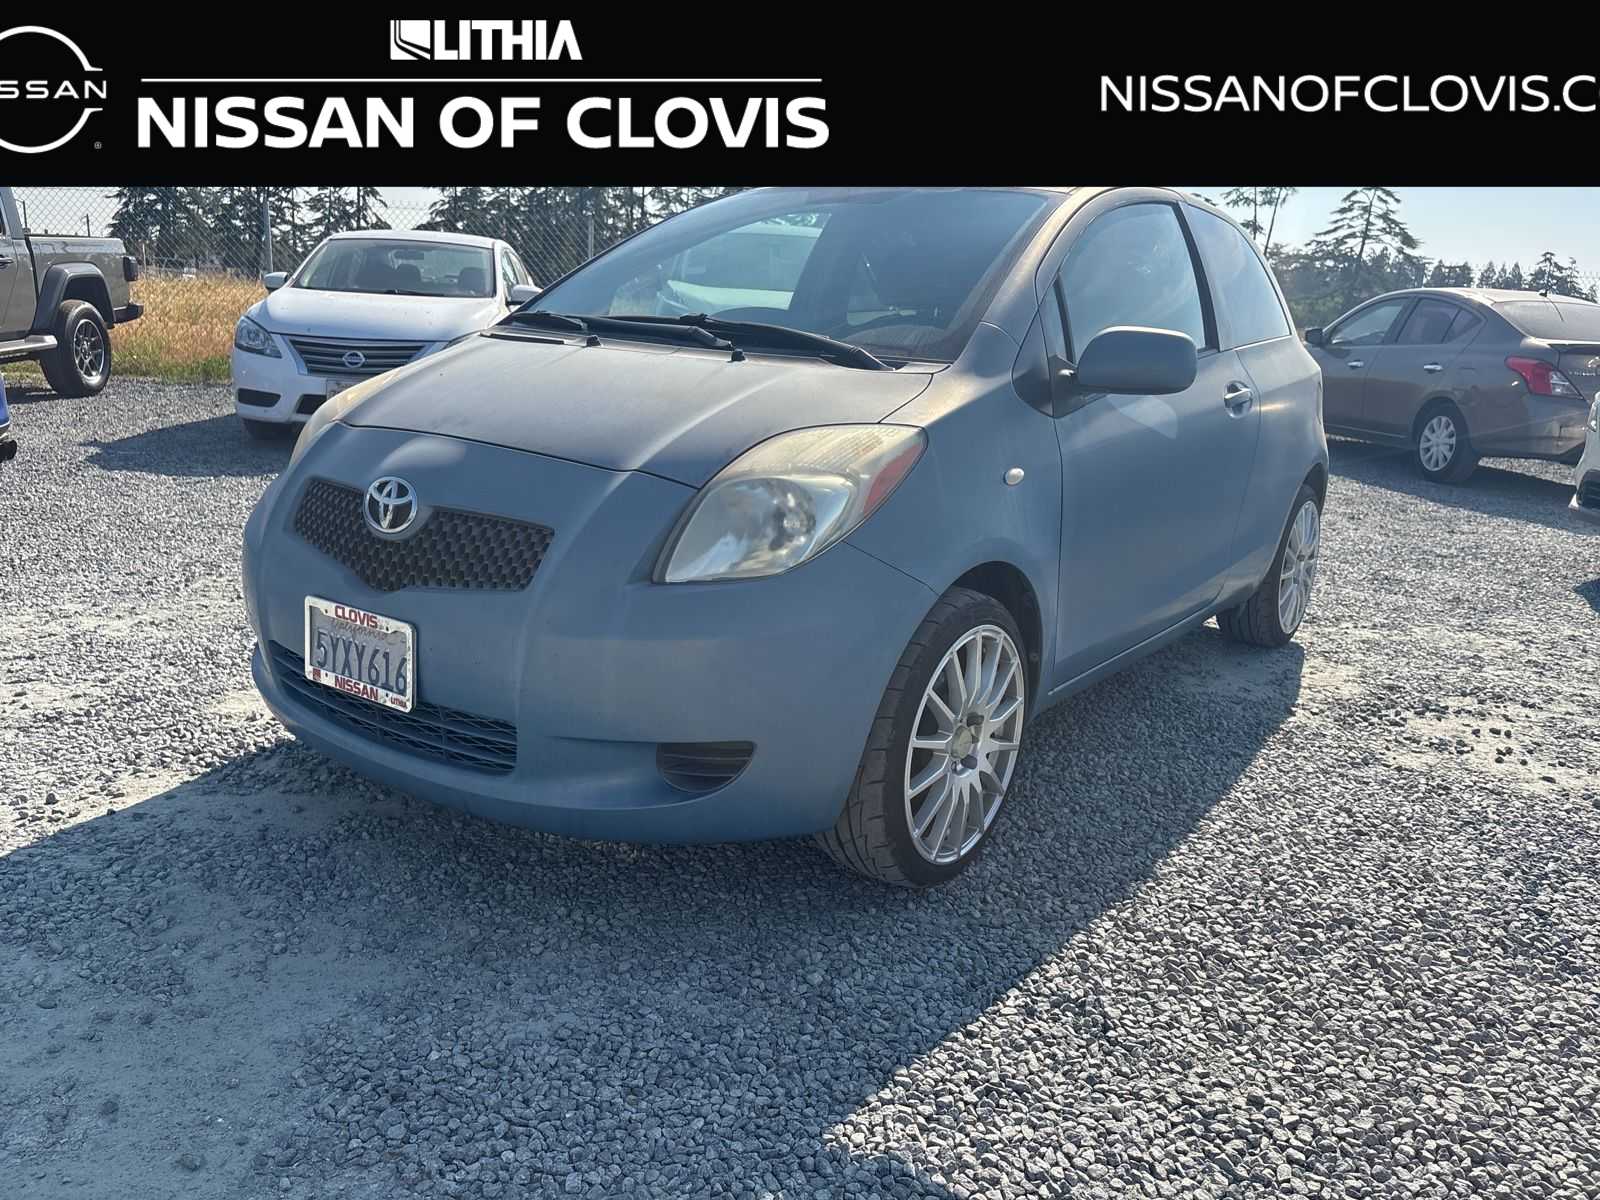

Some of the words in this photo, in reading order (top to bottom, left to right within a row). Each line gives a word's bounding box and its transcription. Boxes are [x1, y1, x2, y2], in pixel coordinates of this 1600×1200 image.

[334, 604, 378, 629] CLOVIS
[316, 628, 408, 695] 5YXY616
[335, 675, 379, 701] NISSAN
